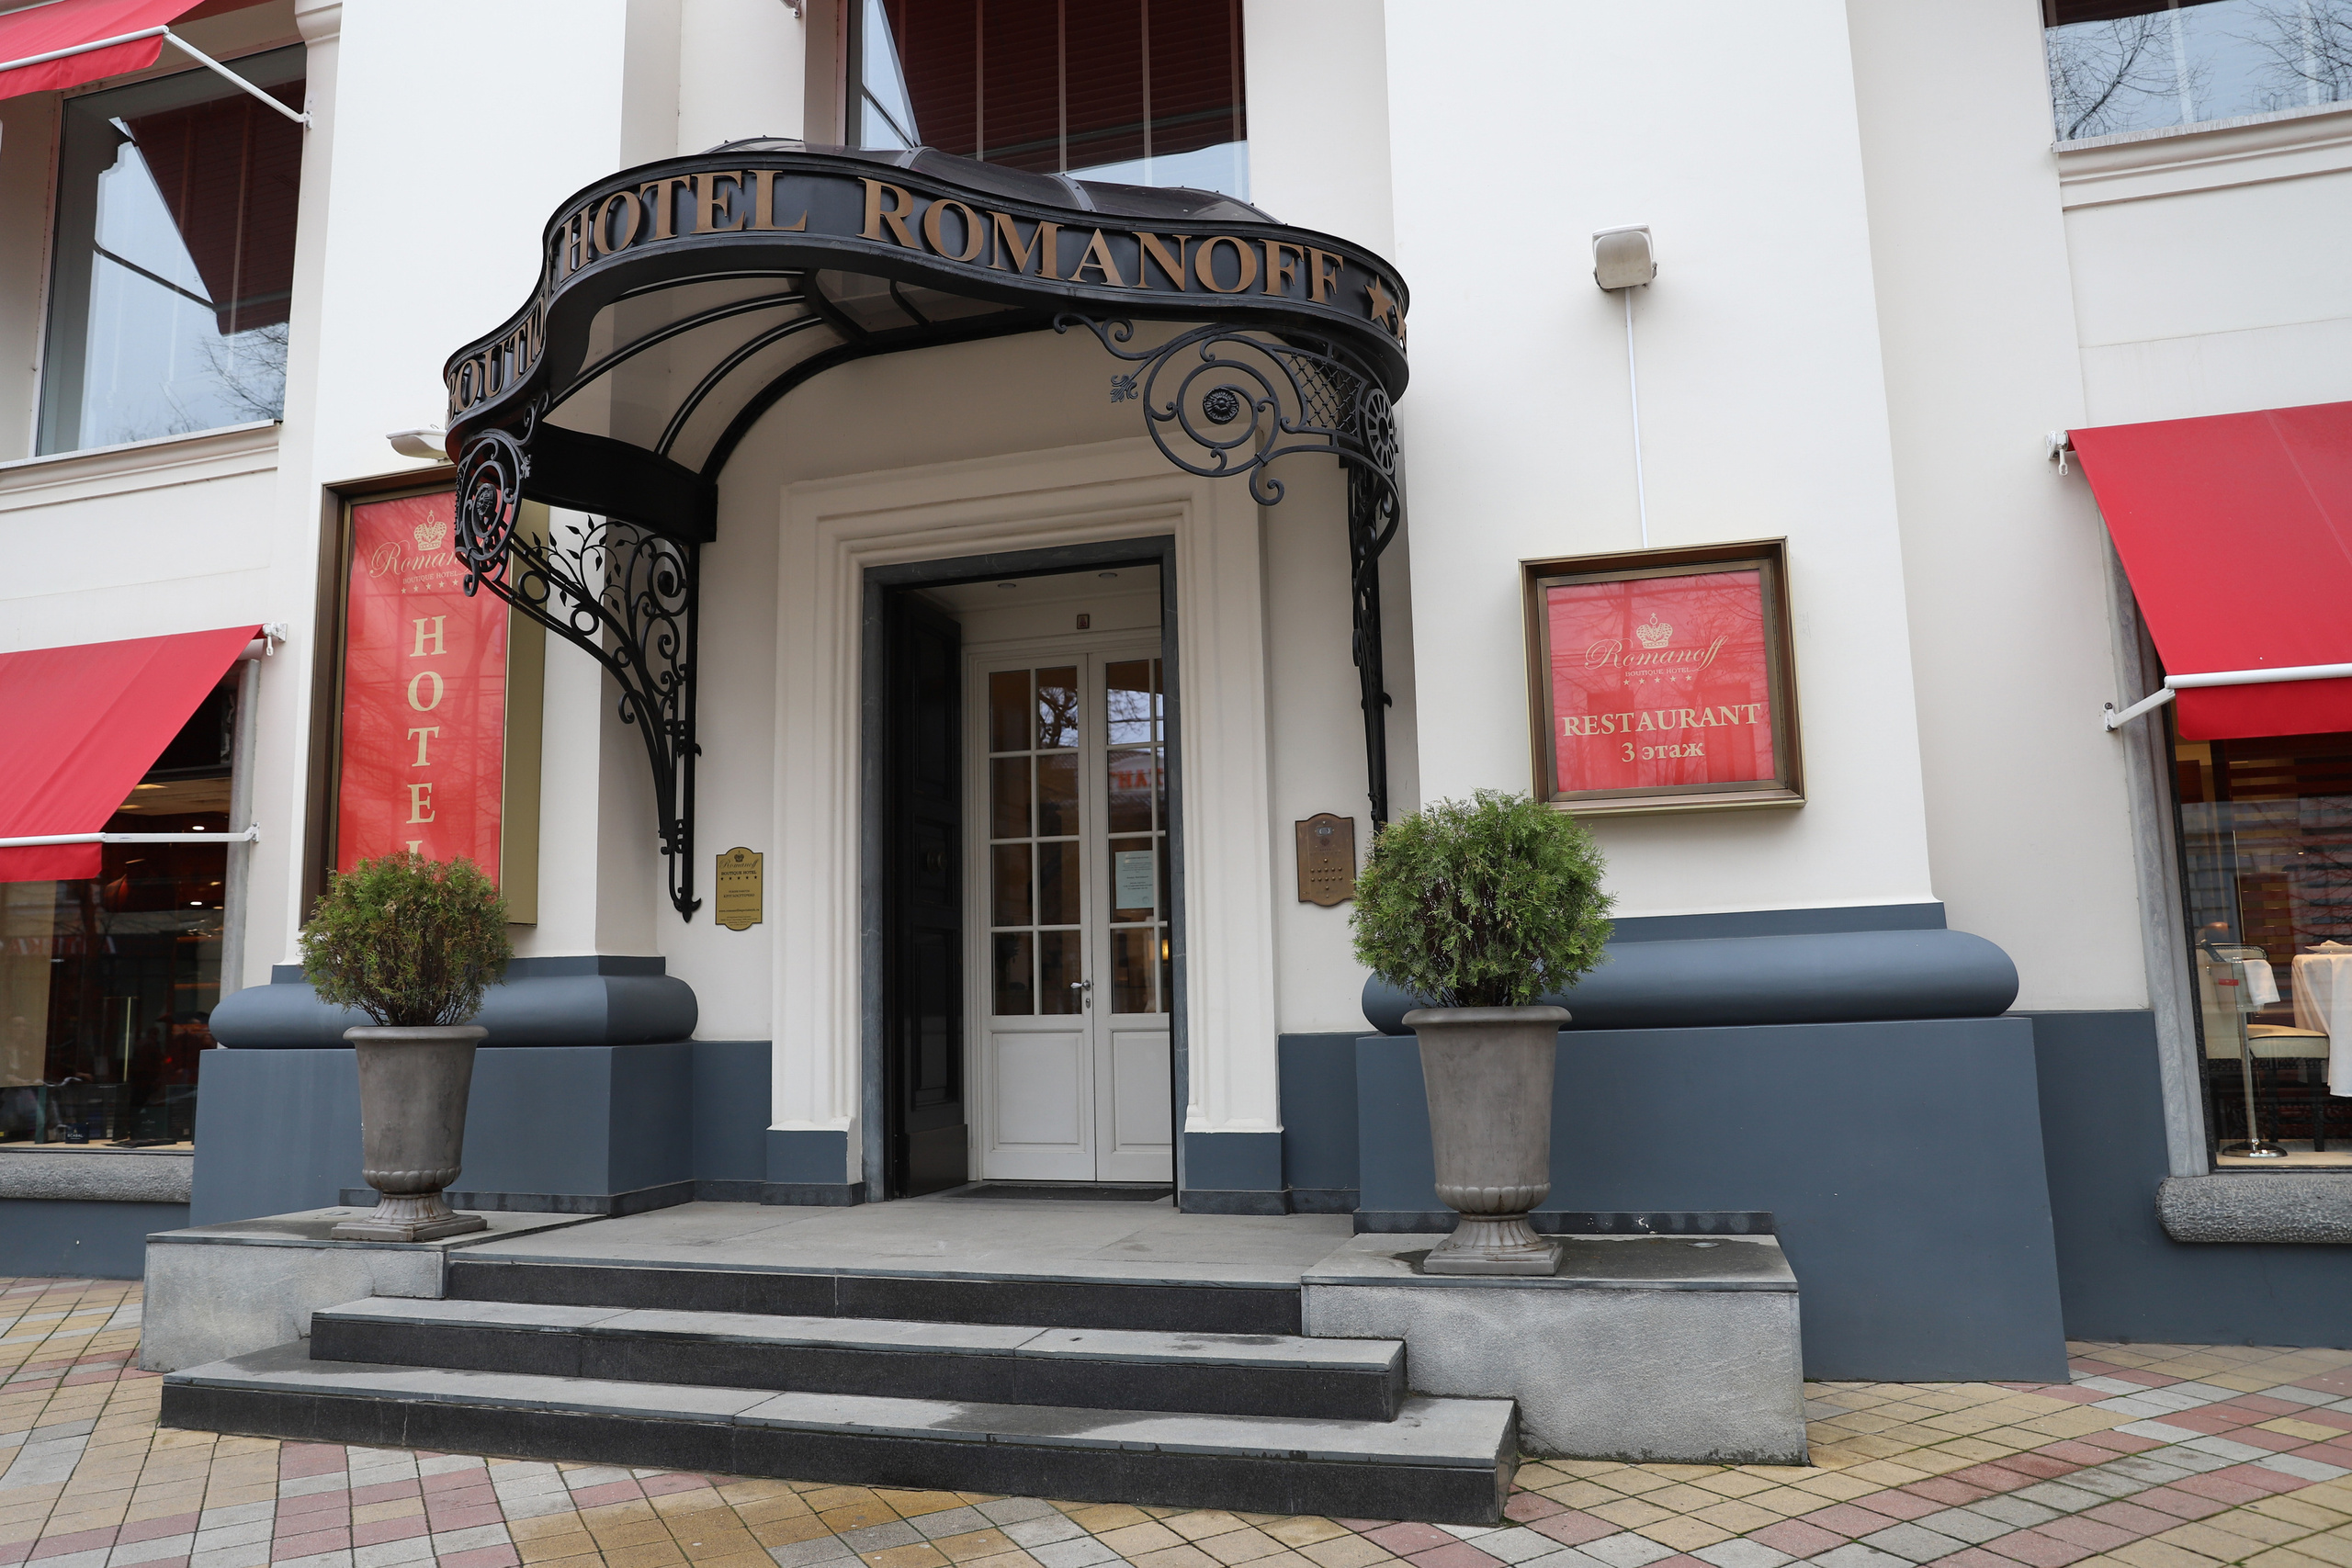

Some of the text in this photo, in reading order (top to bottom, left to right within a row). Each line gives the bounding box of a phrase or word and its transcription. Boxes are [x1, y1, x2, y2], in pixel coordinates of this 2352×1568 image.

[447, 169, 1344, 426] BOUTIQ HOTEL ROMANOFF
[369, 540, 462, 579] Roman
[402, 570, 458, 584] BOUTIQUE HOTEL
[1584, 635, 1728, 671] Romanoff
[1624, 668, 1664, 677] BOUTIQUE
[1562, 703, 1761, 737] RESTAURANT
[1621, 742, 1705, 762] 3 этаж
